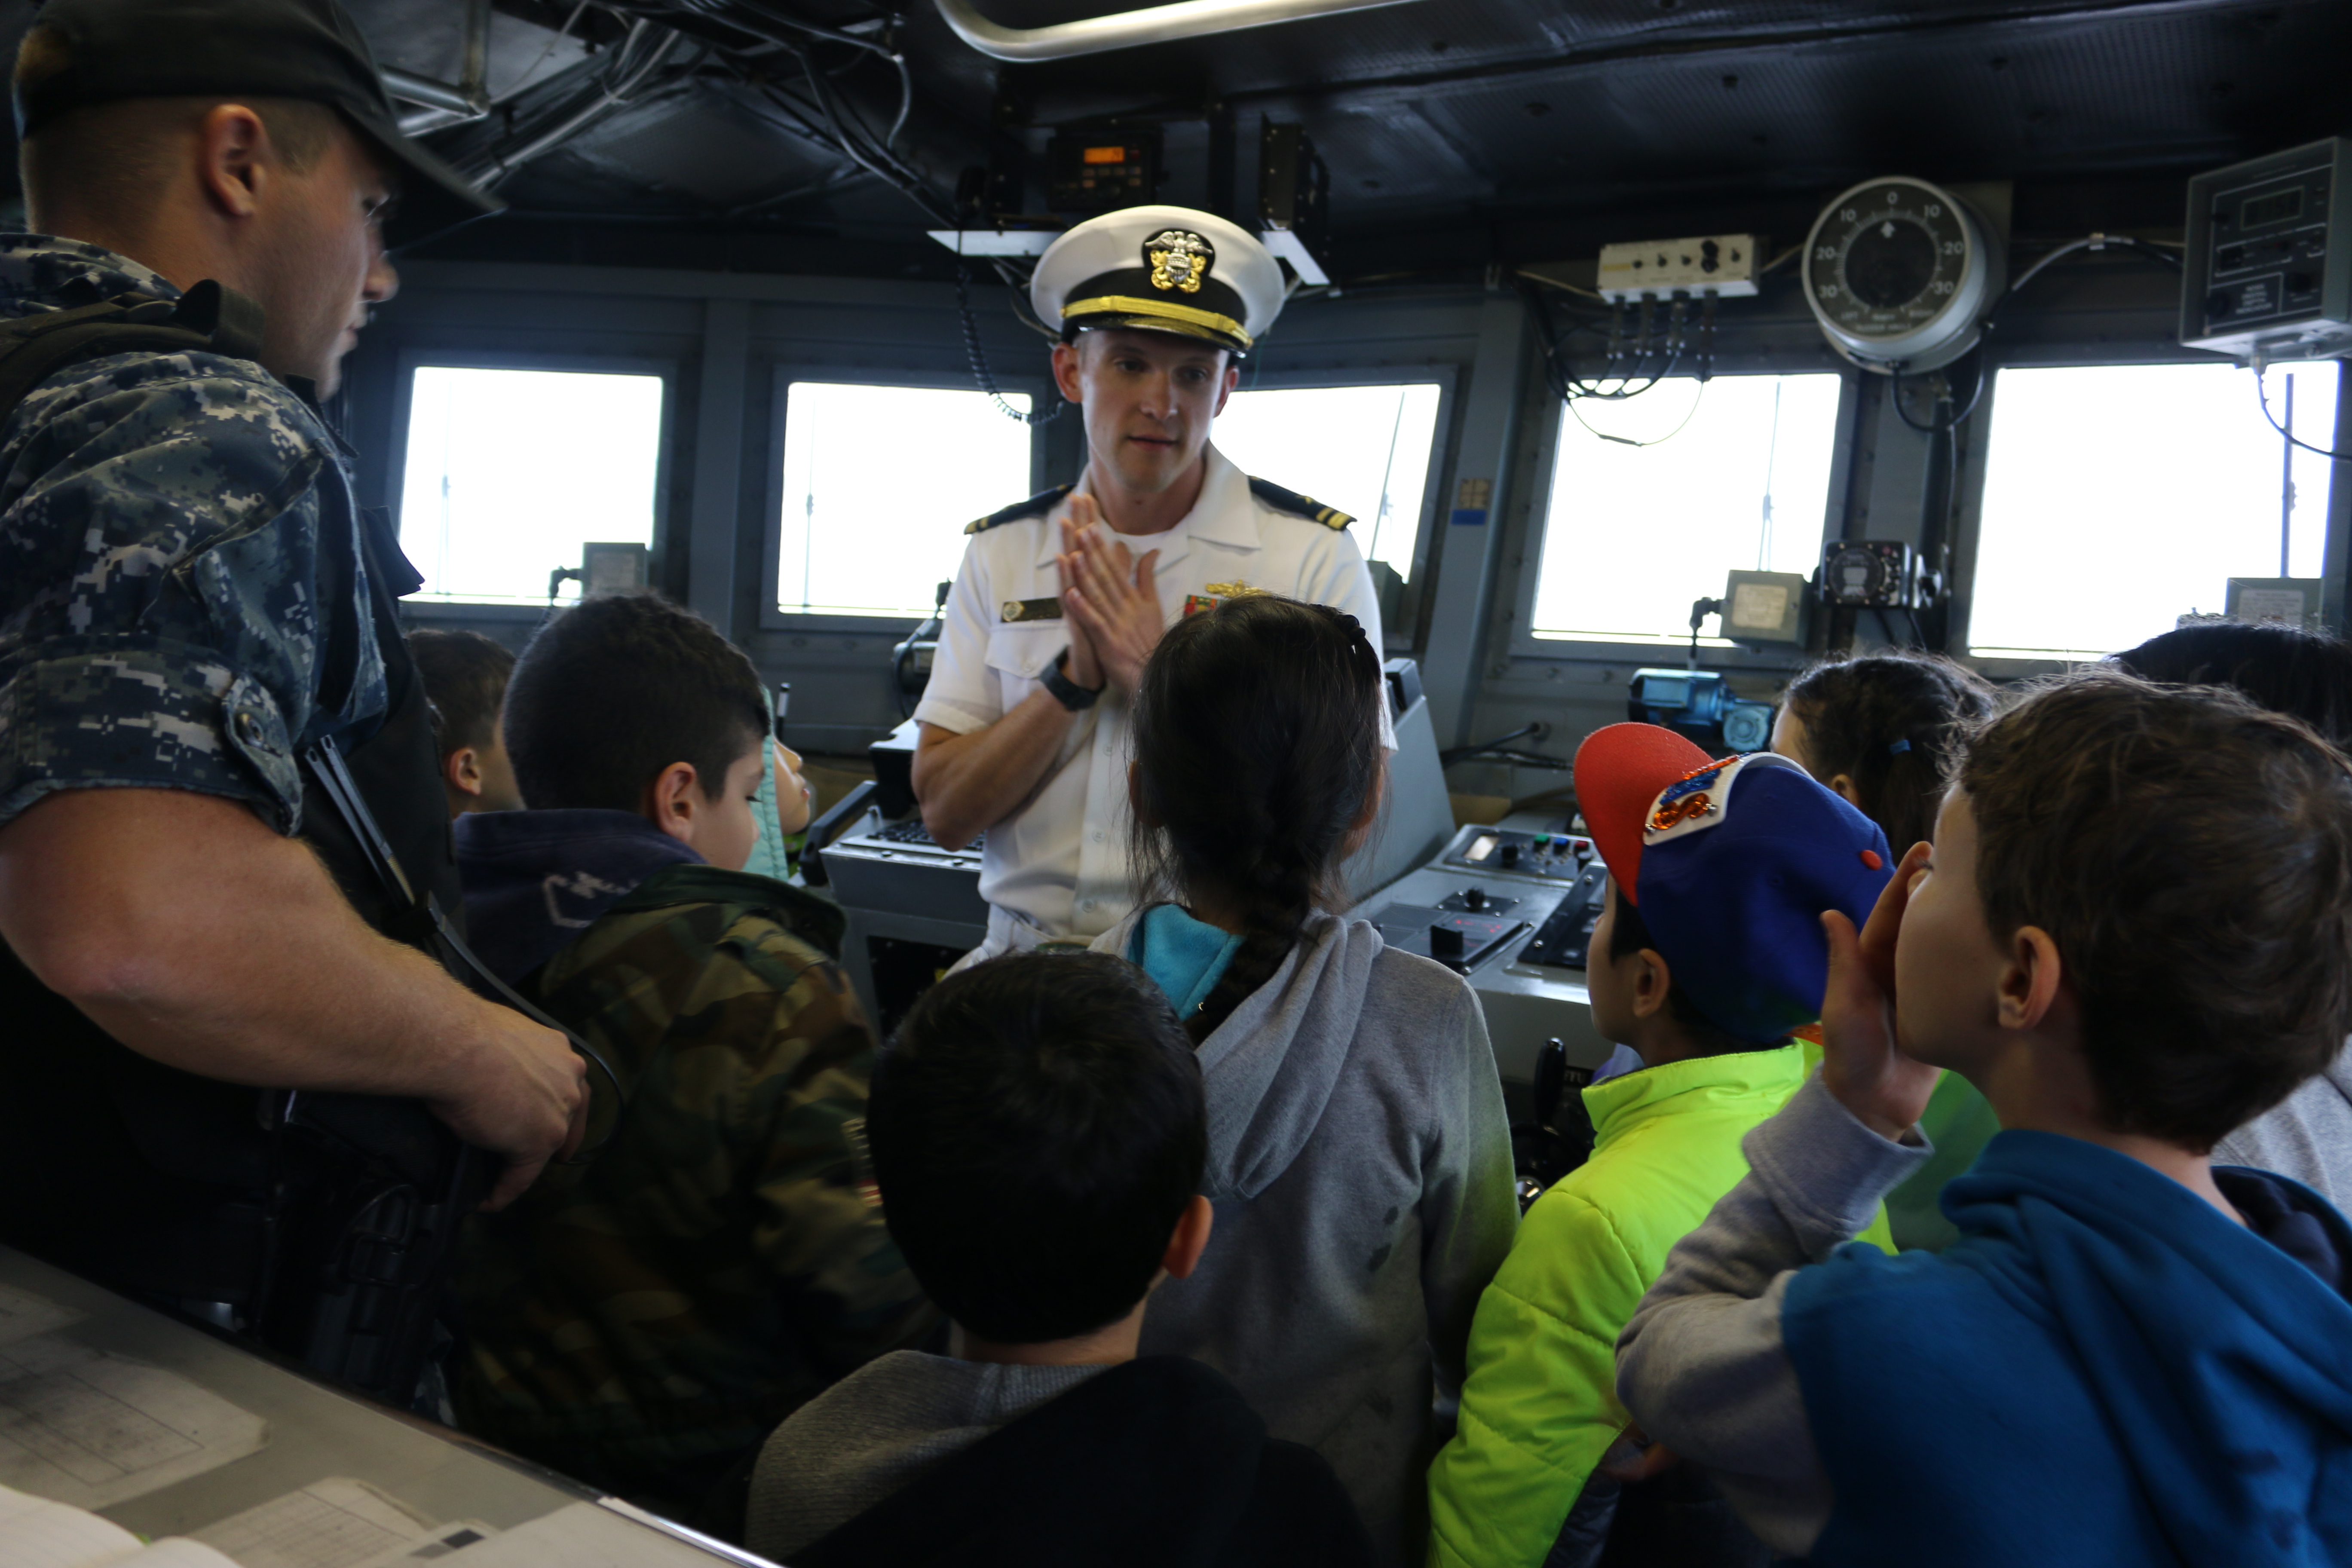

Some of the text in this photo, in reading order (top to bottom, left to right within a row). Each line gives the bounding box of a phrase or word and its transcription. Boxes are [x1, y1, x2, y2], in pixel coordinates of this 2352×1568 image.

[1887, 191, 1898, 204] 0
[1841, 209, 1857, 222] 10
[1924, 205, 1940, 218] 10
[1816, 246, 1836, 260] 20
[1944, 242, 1964, 255] 20
[1819, 285, 1838, 298] 30
[1935, 282, 1954, 295] 30
